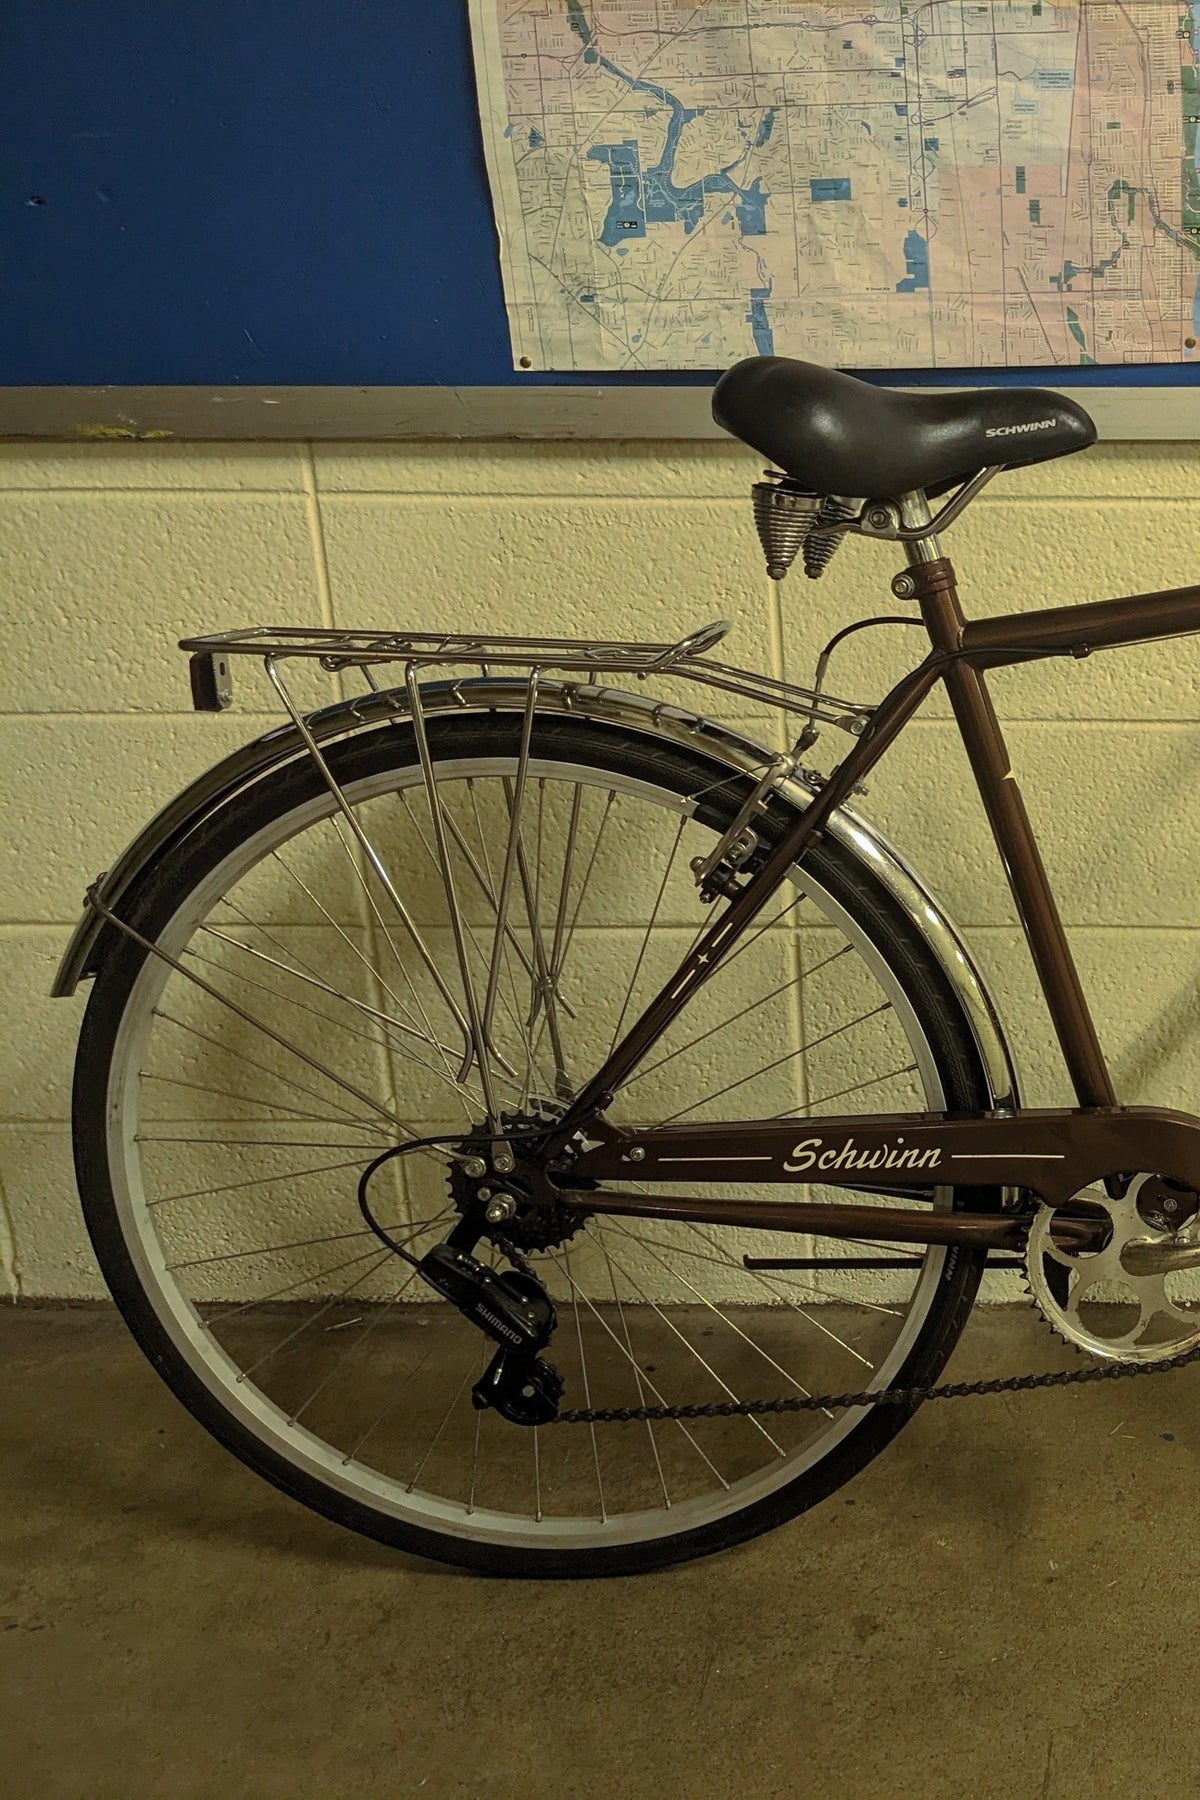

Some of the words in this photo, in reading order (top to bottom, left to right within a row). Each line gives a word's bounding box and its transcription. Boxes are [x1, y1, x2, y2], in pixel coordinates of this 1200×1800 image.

[985, 418, 1056, 438] SCHWINN
[783, 1137, 942, 1172] Schwinn
[475, 1302, 522, 1344] SHIMANO
